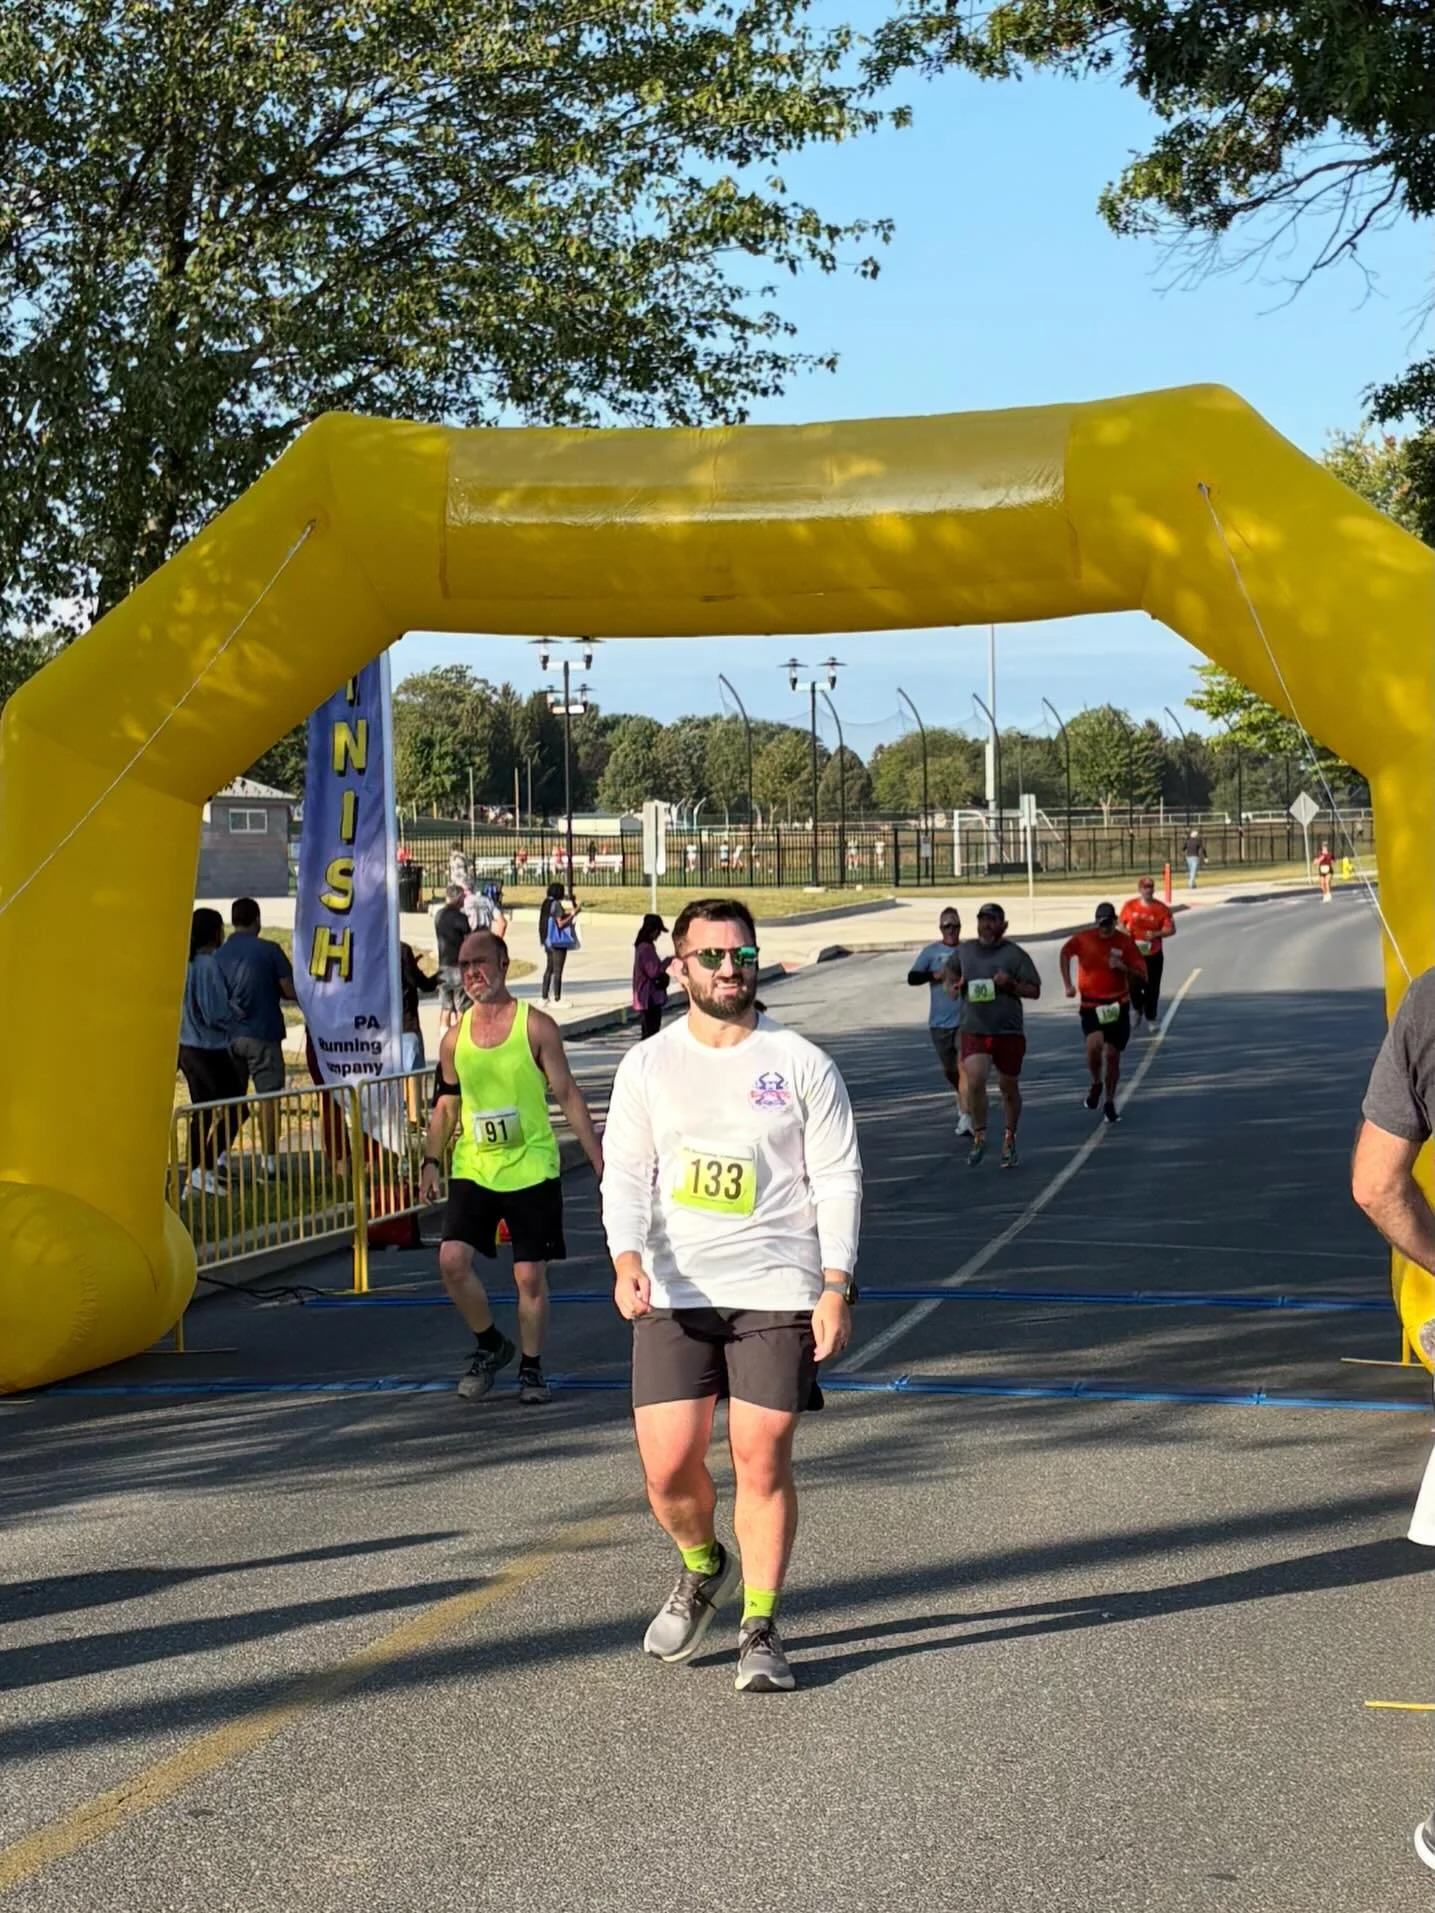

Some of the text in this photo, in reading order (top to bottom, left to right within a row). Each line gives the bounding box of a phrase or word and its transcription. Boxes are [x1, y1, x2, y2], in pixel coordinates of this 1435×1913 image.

[354, 1015, 381, 1029] PA
[485, 1119, 508, 1142] 91
[691, 1159, 743, 1200] 133
